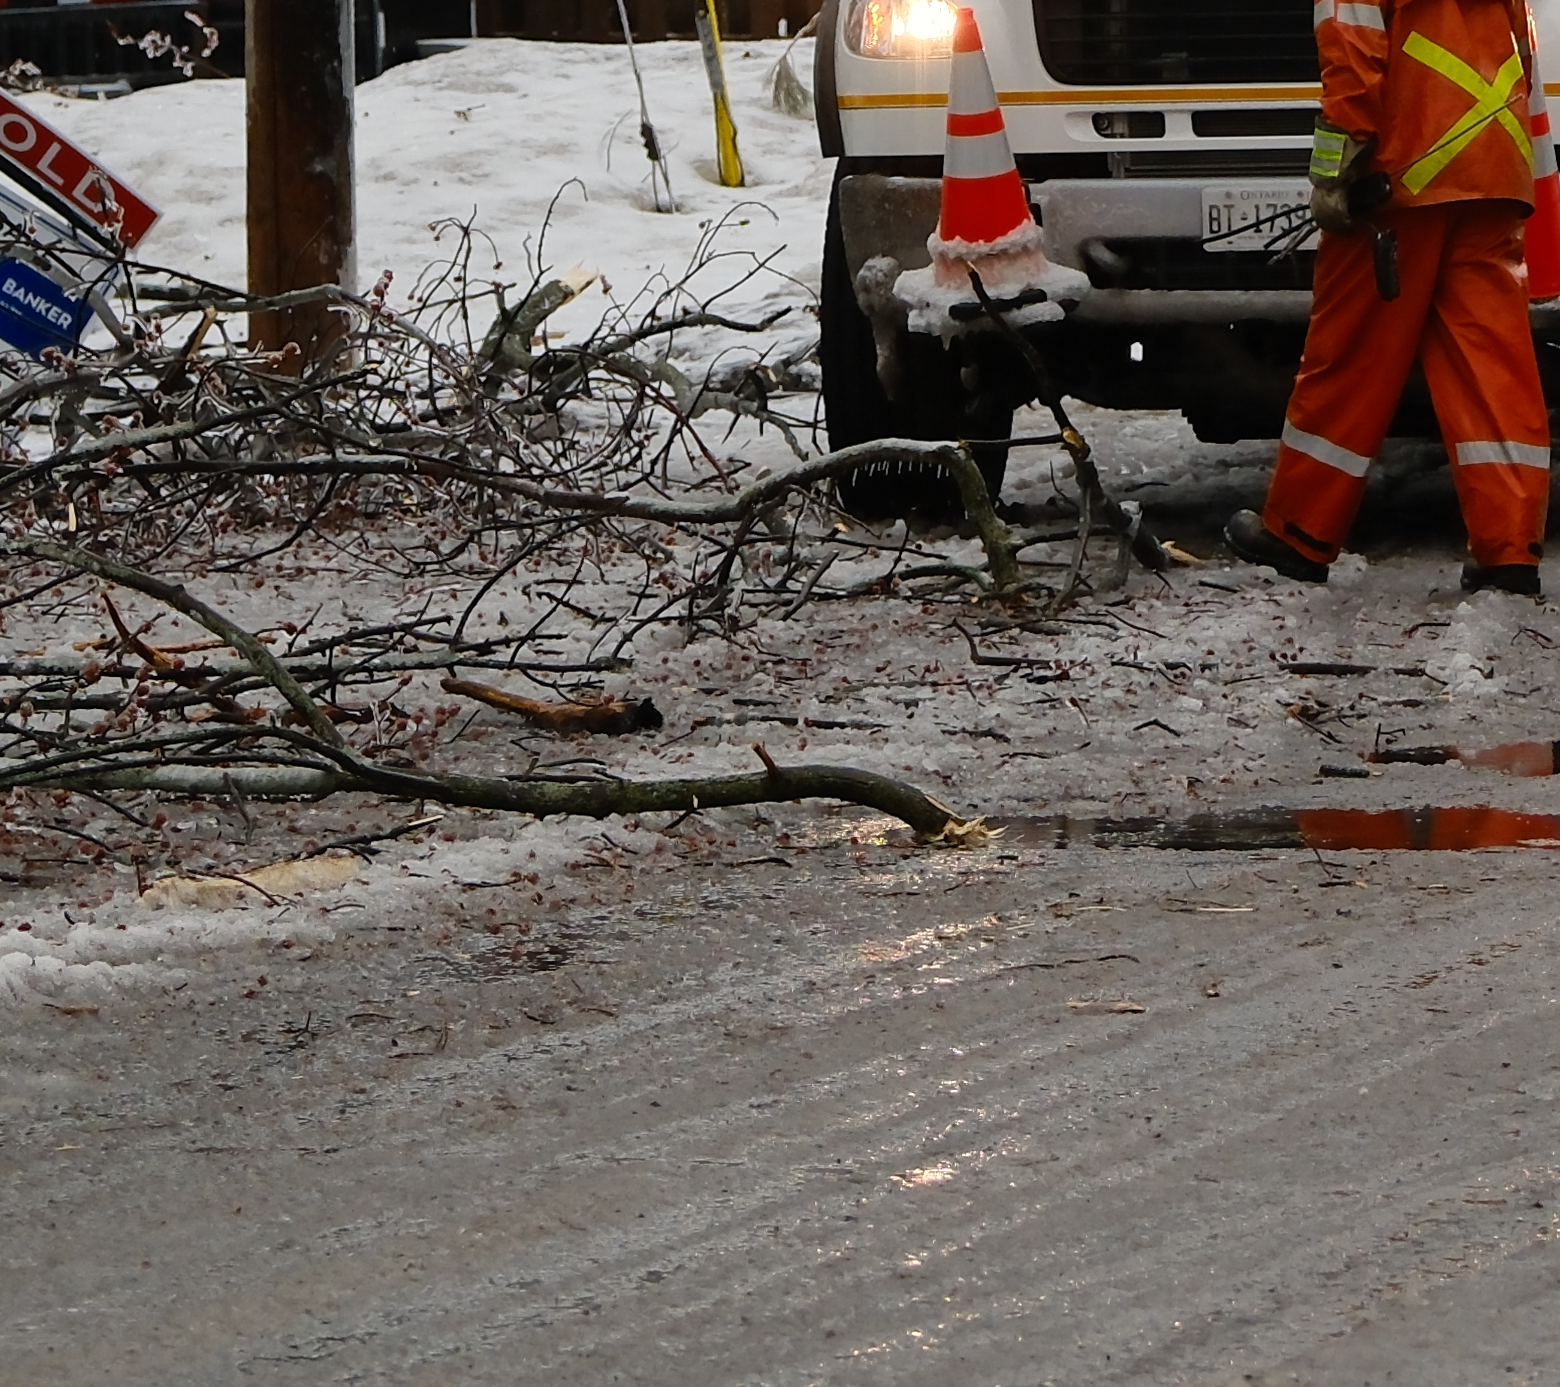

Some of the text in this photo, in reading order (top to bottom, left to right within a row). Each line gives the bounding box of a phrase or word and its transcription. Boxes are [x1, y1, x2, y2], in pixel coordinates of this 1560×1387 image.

[1208, 202, 1308, 235] BT 1739
[1, 277, 73, 330] BANKER
